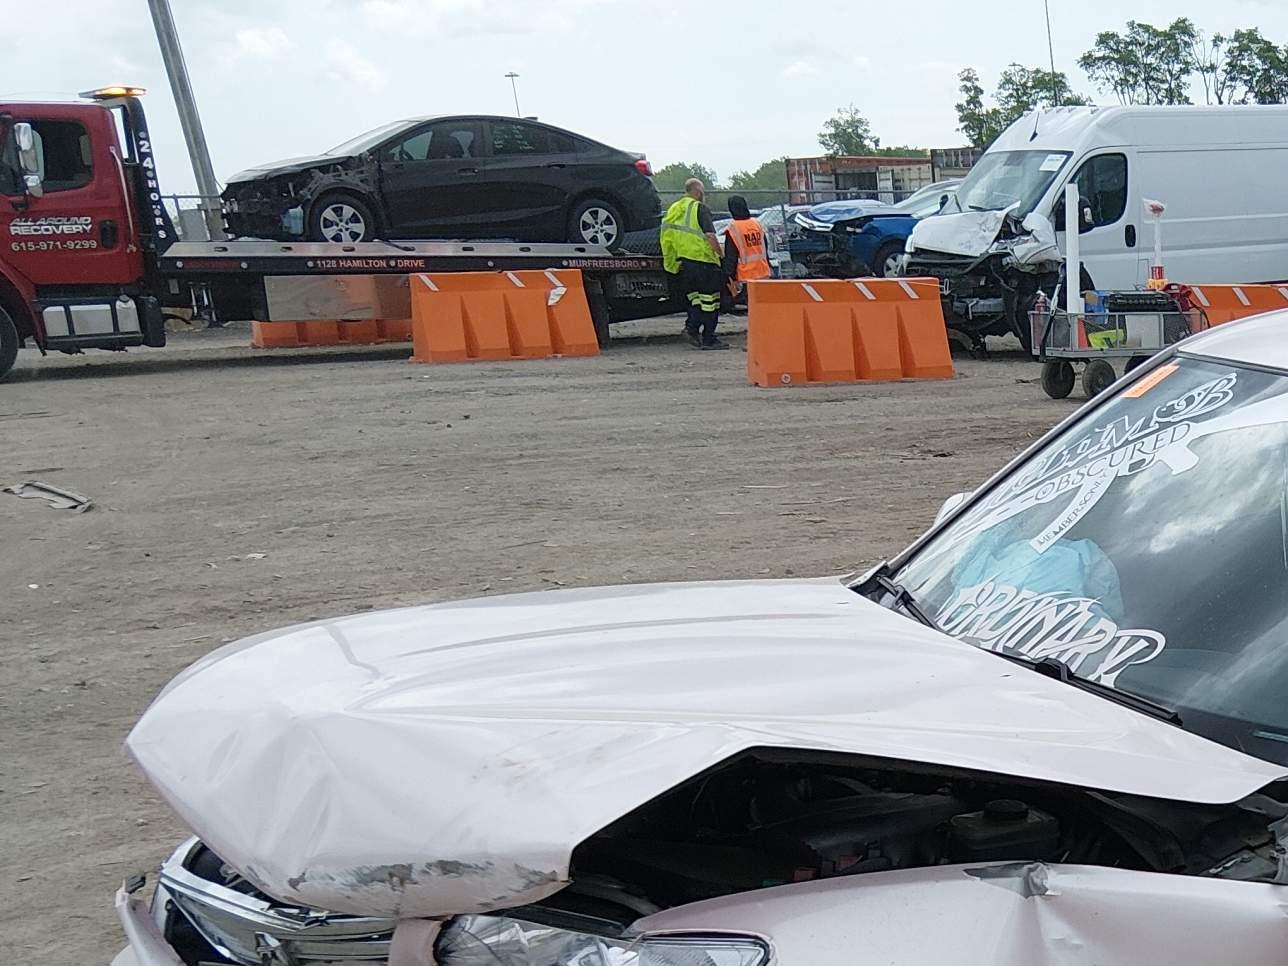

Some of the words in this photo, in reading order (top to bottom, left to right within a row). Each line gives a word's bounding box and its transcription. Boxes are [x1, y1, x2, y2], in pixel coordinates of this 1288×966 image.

[139, 140, 154, 169] 24
[147, 180, 167, 239] HORS
[10, 217, 35, 226] ALL
[36, 216, 92, 225] AROUND
[10, 224, 92, 235] RECOVERY
[11, 239, 97, 251] 615-971-9299
[317, 259, 337, 268] 1128
[339, 259, 387, 268] HAMILTON
[397, 259, 425, 268] DRIVE
[568, 260, 641, 268] MURFREESBORO
[1035, 423, 1192, 501] OBSCURED
